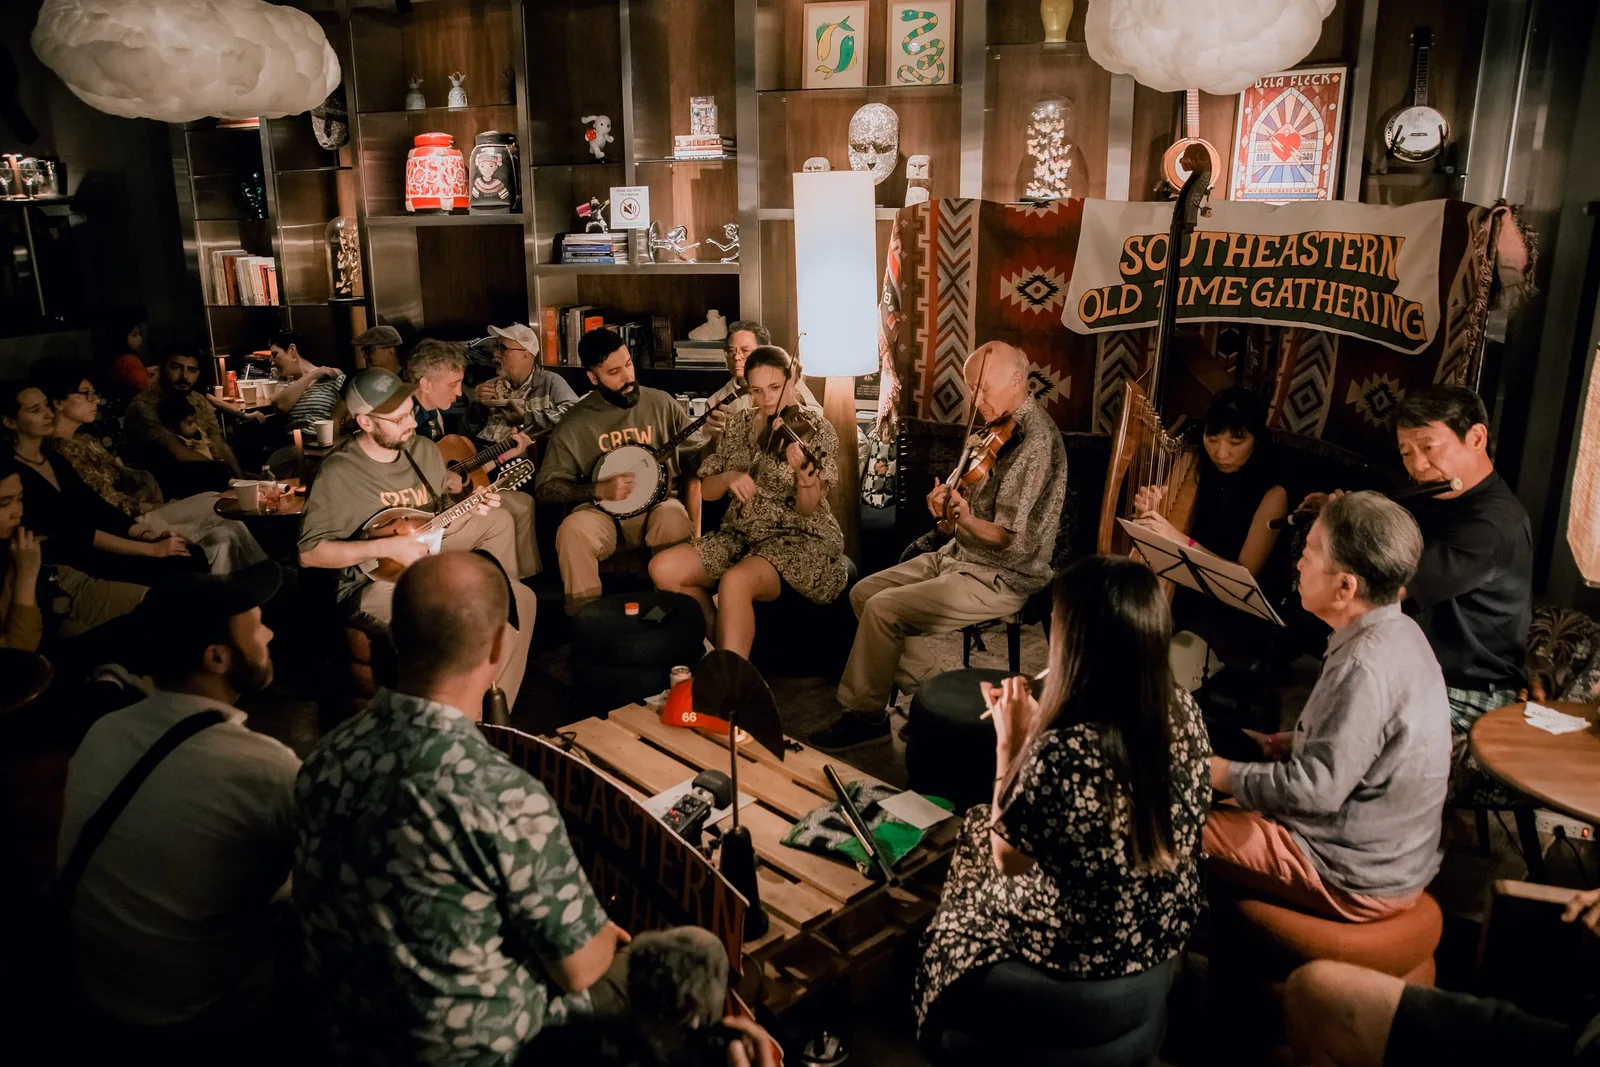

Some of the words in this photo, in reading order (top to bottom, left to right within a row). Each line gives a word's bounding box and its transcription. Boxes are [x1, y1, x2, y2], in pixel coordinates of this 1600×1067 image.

[1290, 74, 1331, 87] FLECK
[1120, 231, 1406, 281] SOUTHEASTERN
[1079, 284, 1143, 323] OLD
[1250, 277, 1427, 342] GATHERING
[598, 425, 652, 452] CREW
[682, 711, 697, 723] 66
[495, 727, 746, 967] THEASTERN
